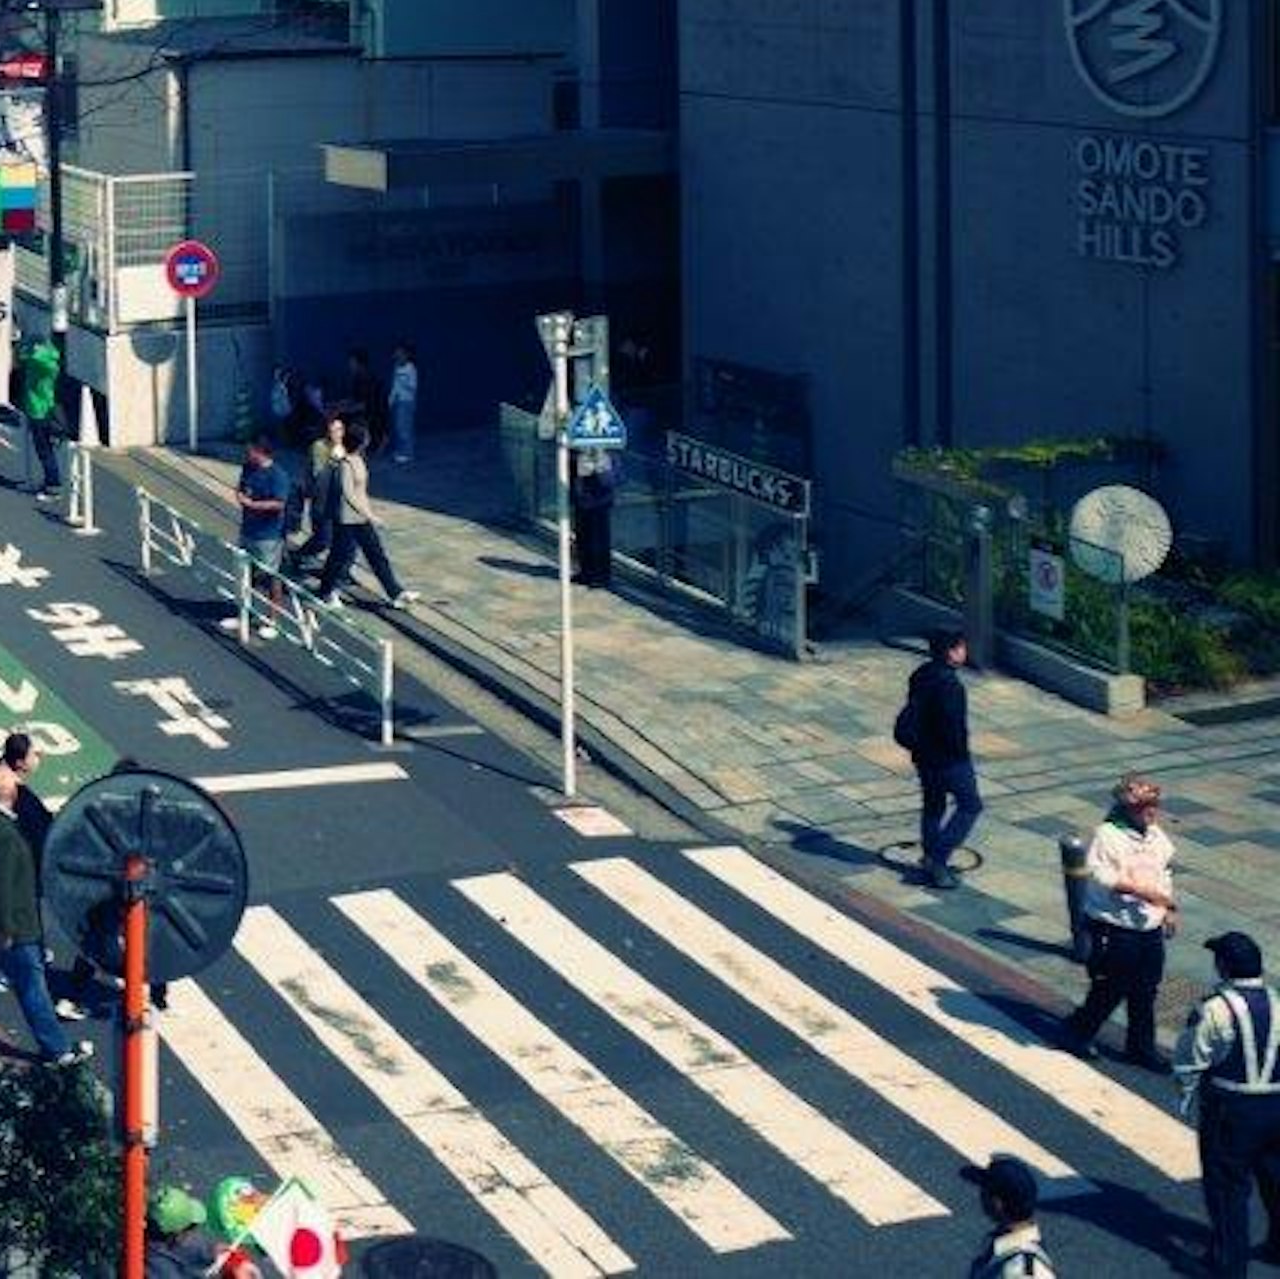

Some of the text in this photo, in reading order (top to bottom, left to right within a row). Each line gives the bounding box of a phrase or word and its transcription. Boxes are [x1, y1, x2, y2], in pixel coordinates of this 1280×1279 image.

[1077, 137, 1210, 186] OMOTE
[1078, 178, 1206, 228] SANDO
[1077, 219, 1176, 268] HILLS
[667, 441, 792, 507] STARBUCKS
